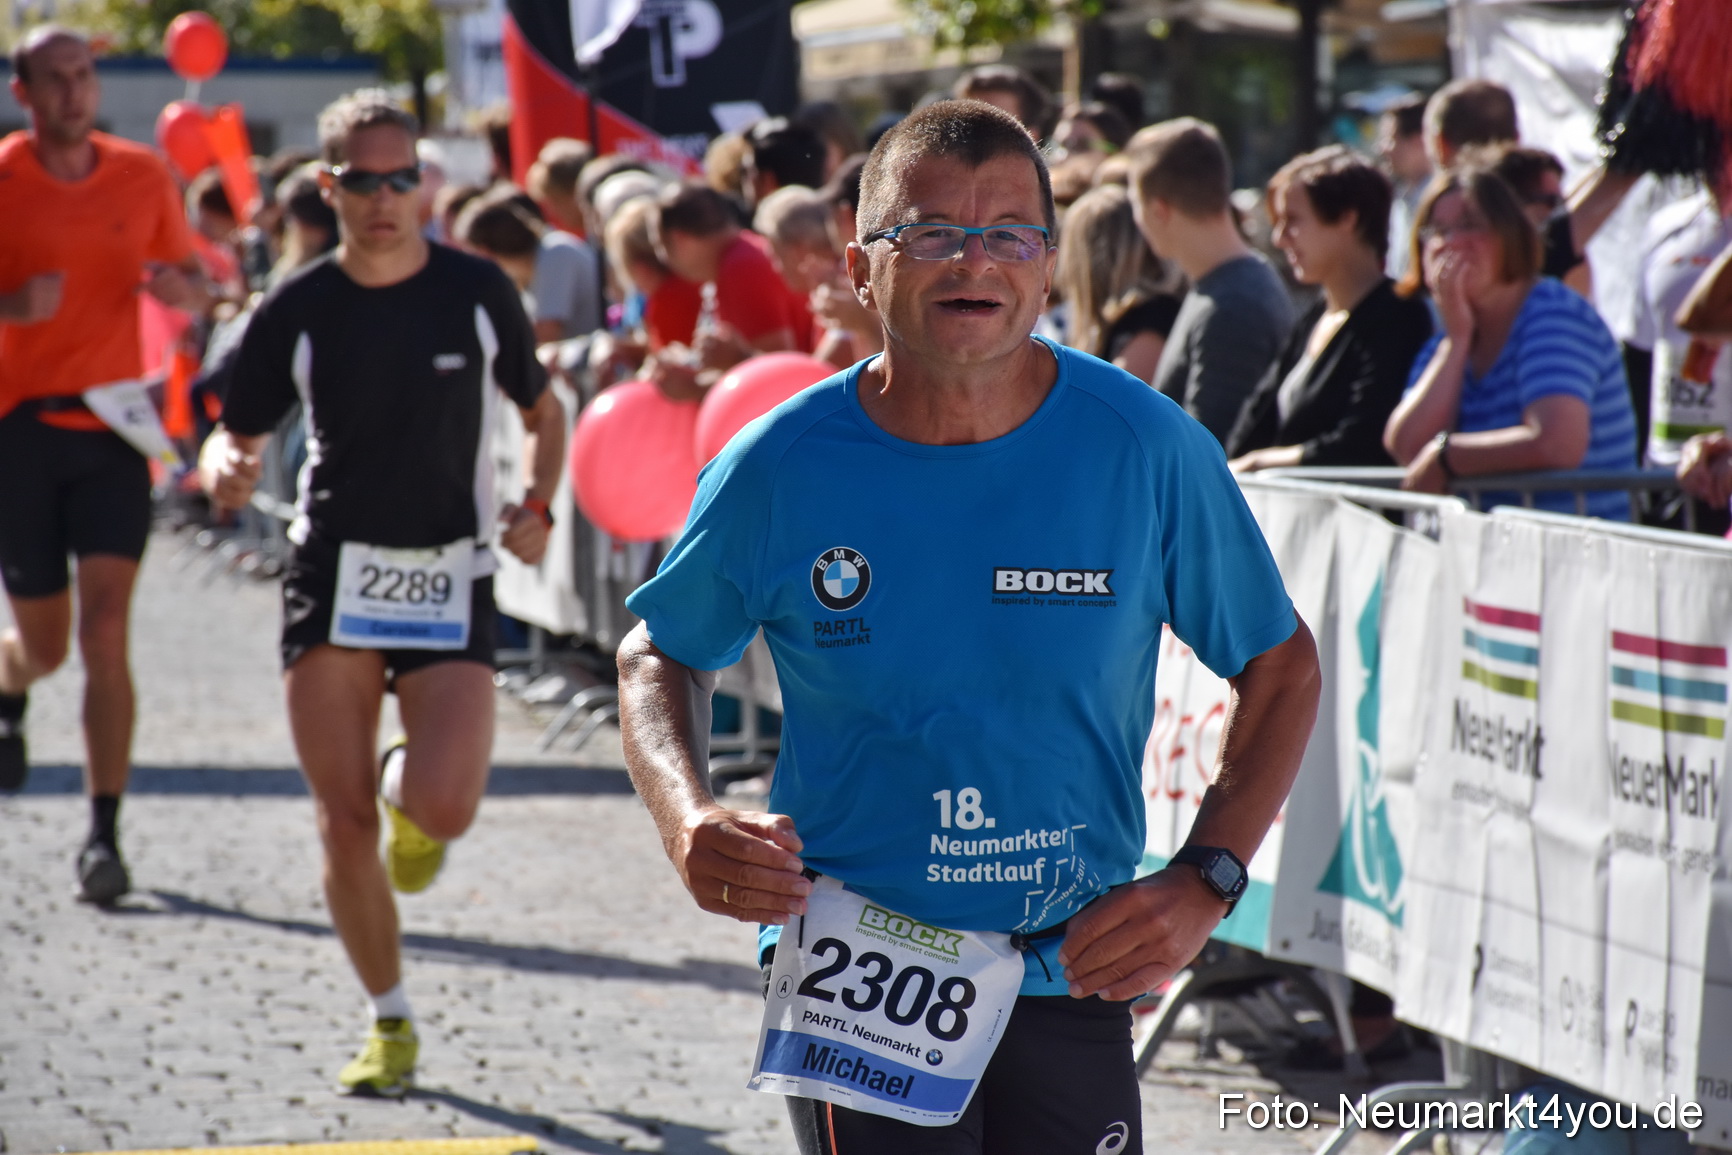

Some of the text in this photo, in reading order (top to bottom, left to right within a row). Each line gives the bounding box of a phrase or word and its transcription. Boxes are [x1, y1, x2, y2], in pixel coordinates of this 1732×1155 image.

[815, 549, 867, 572] BMW
[359, 563, 452, 605] 2289
[994, 568, 1111, 595] BOCK
[991, 595, 1117, 609] inspired by smart concepts
[813, 617, 871, 637] PARTL
[814, 632, 871, 649] Neumarkt
[932, 786, 996, 831] 18.
[930, 827, 1068, 857] Neumarkter
[926, 857, 1047, 885] Stadtlauf
[1032, 881, 1078, 928] September
[1075, 857, 1087, 884] 2017
[855, 926, 959, 965] inspired by smart concepts
[859, 904, 964, 957] BOCK
[779, 980, 788, 994] A
[797, 937, 977, 1043] 2308
[802, 1010, 922, 1059] PARTL Neumarkt
[801, 1042, 915, 1100] Michael
